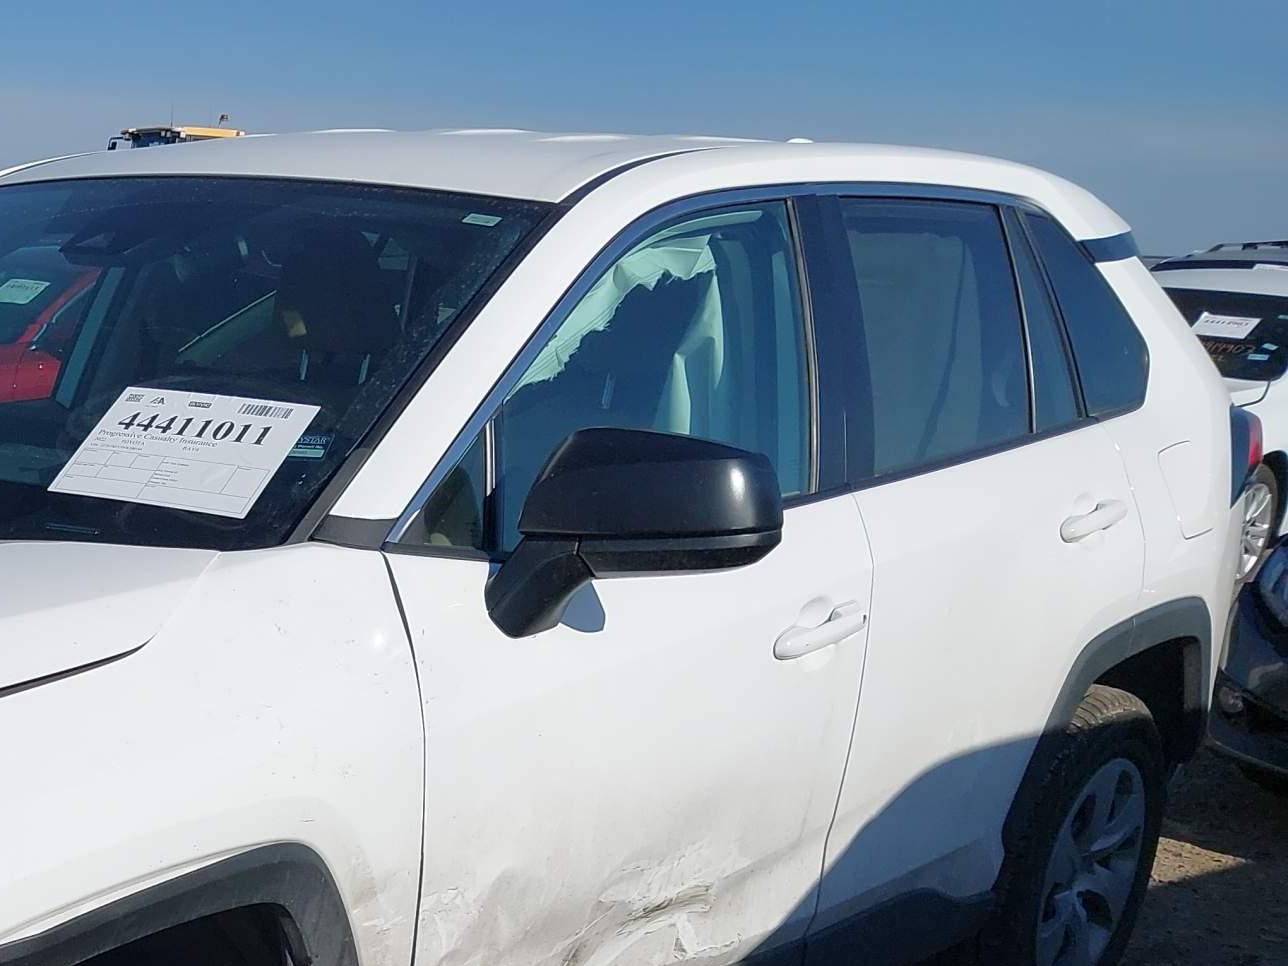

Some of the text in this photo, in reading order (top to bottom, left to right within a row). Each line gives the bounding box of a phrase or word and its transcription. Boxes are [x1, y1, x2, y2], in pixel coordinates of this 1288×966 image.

[117, 411, 272, 446] 44411011
[98, 429, 218, 448] Progressive Casualty Insurance
[121, 439, 146, 447] TOYOTA
